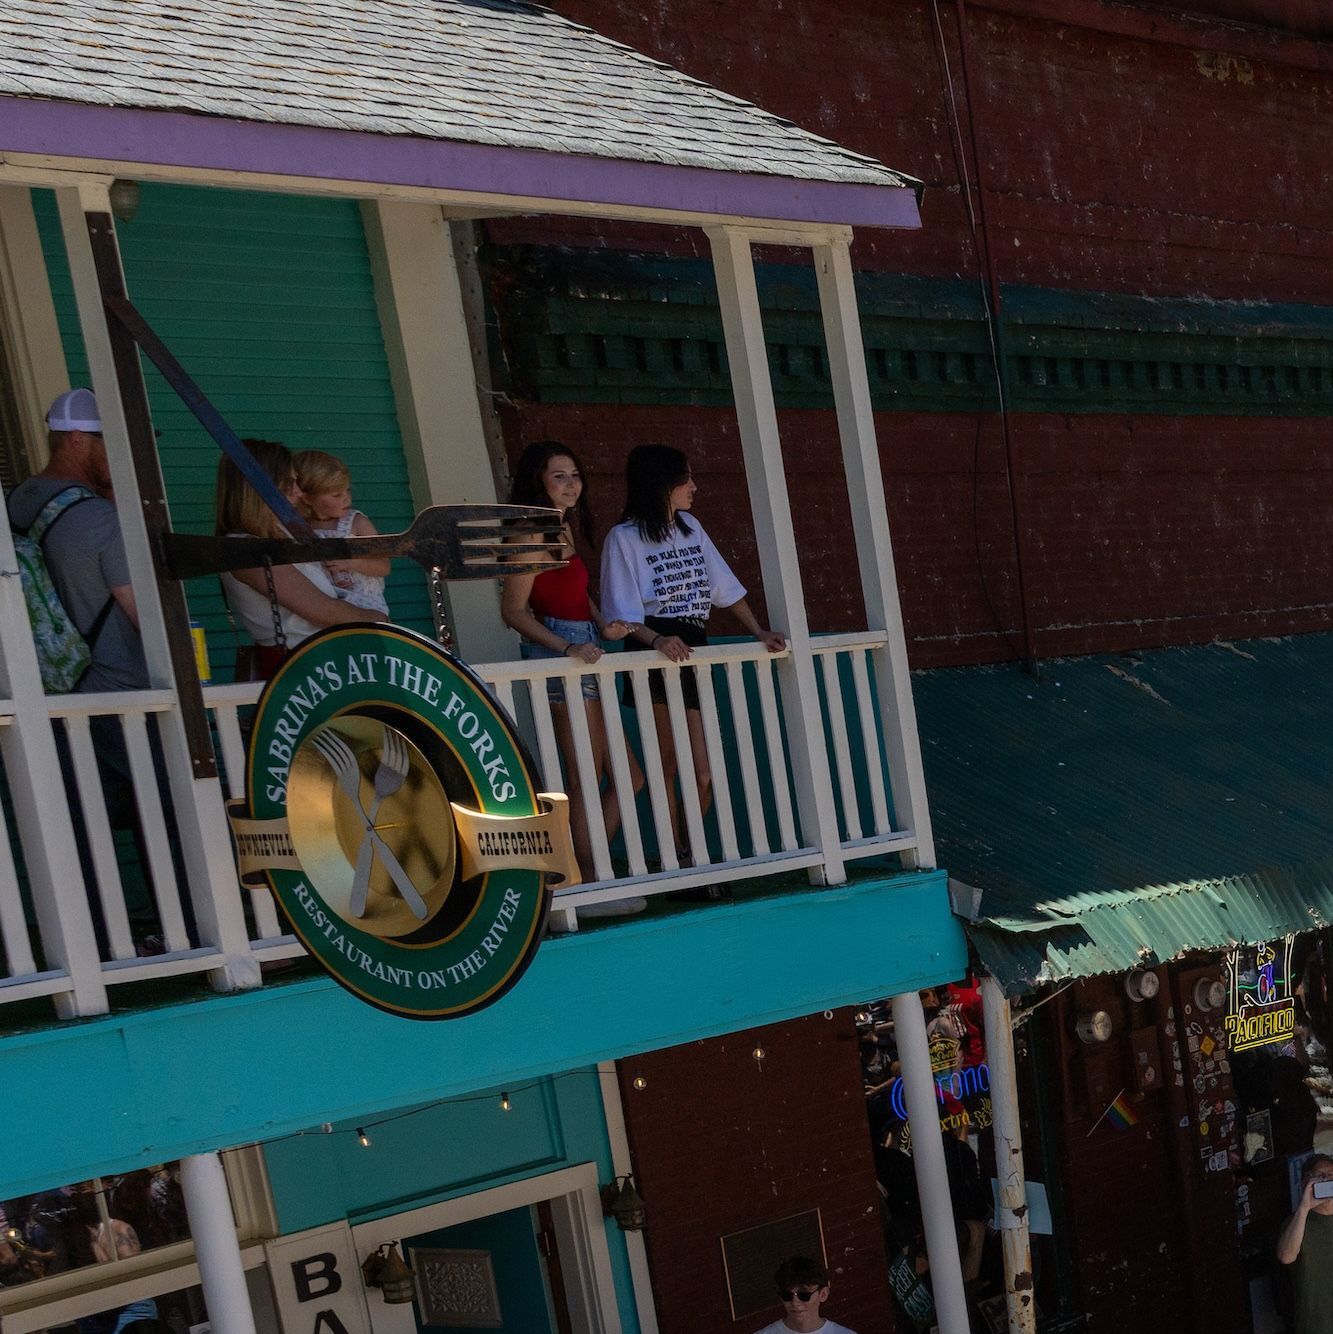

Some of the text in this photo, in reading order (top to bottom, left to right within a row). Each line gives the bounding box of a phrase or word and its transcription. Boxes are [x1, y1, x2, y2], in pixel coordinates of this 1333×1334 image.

[266, 654, 518, 805] SABRINA'S AT THE FORKS
[477, 831, 553, 856] CALIFORNIA
[292, 880, 522, 991] RESTAURANT ON THE RIVER
[1225, 1007, 1294, 1049] PACIFICO
[890, 1064, 991, 1121] Crona
